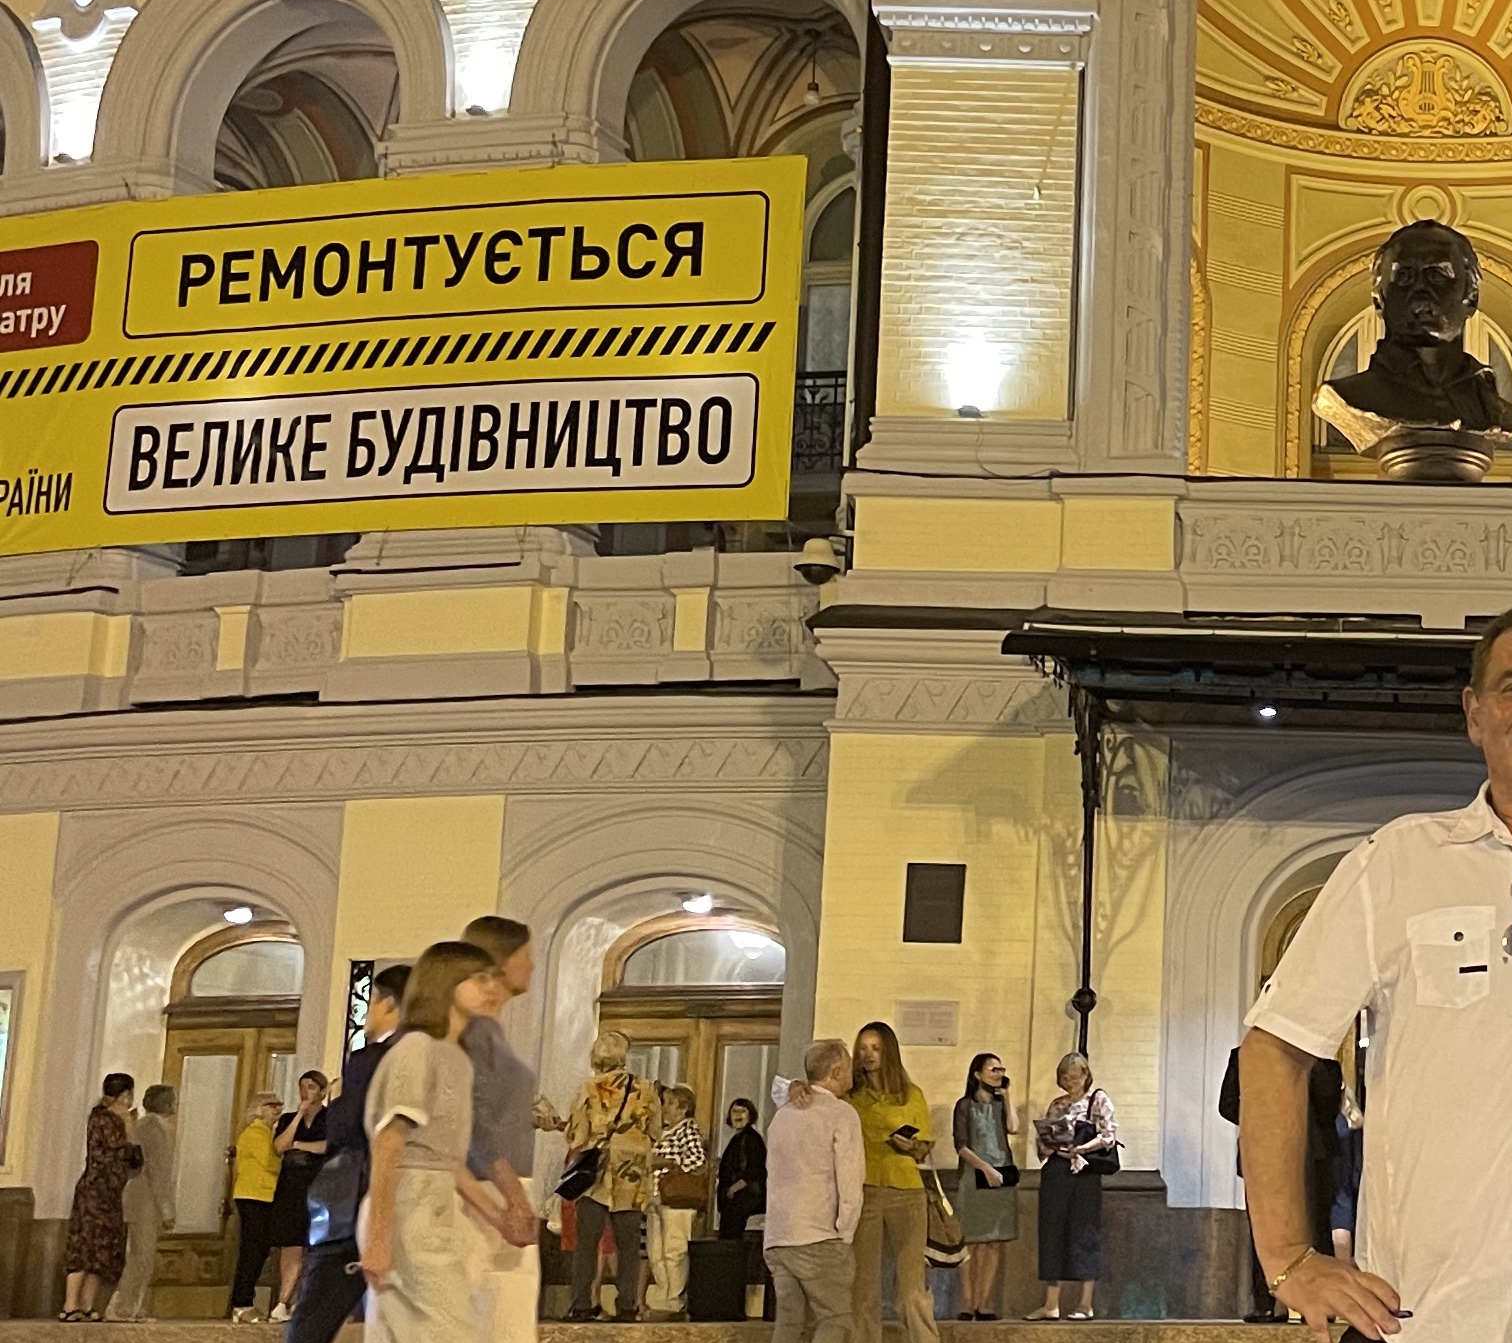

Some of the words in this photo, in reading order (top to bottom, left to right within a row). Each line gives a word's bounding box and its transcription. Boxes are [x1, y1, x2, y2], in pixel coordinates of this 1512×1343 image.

[178, 221, 705, 308] РЕМОНТУЄТЬСЯ
[128, 412, 332, 492] ВЕЛИКЕ
[348, 395, 734, 487] БУДІВНИЦТВО
